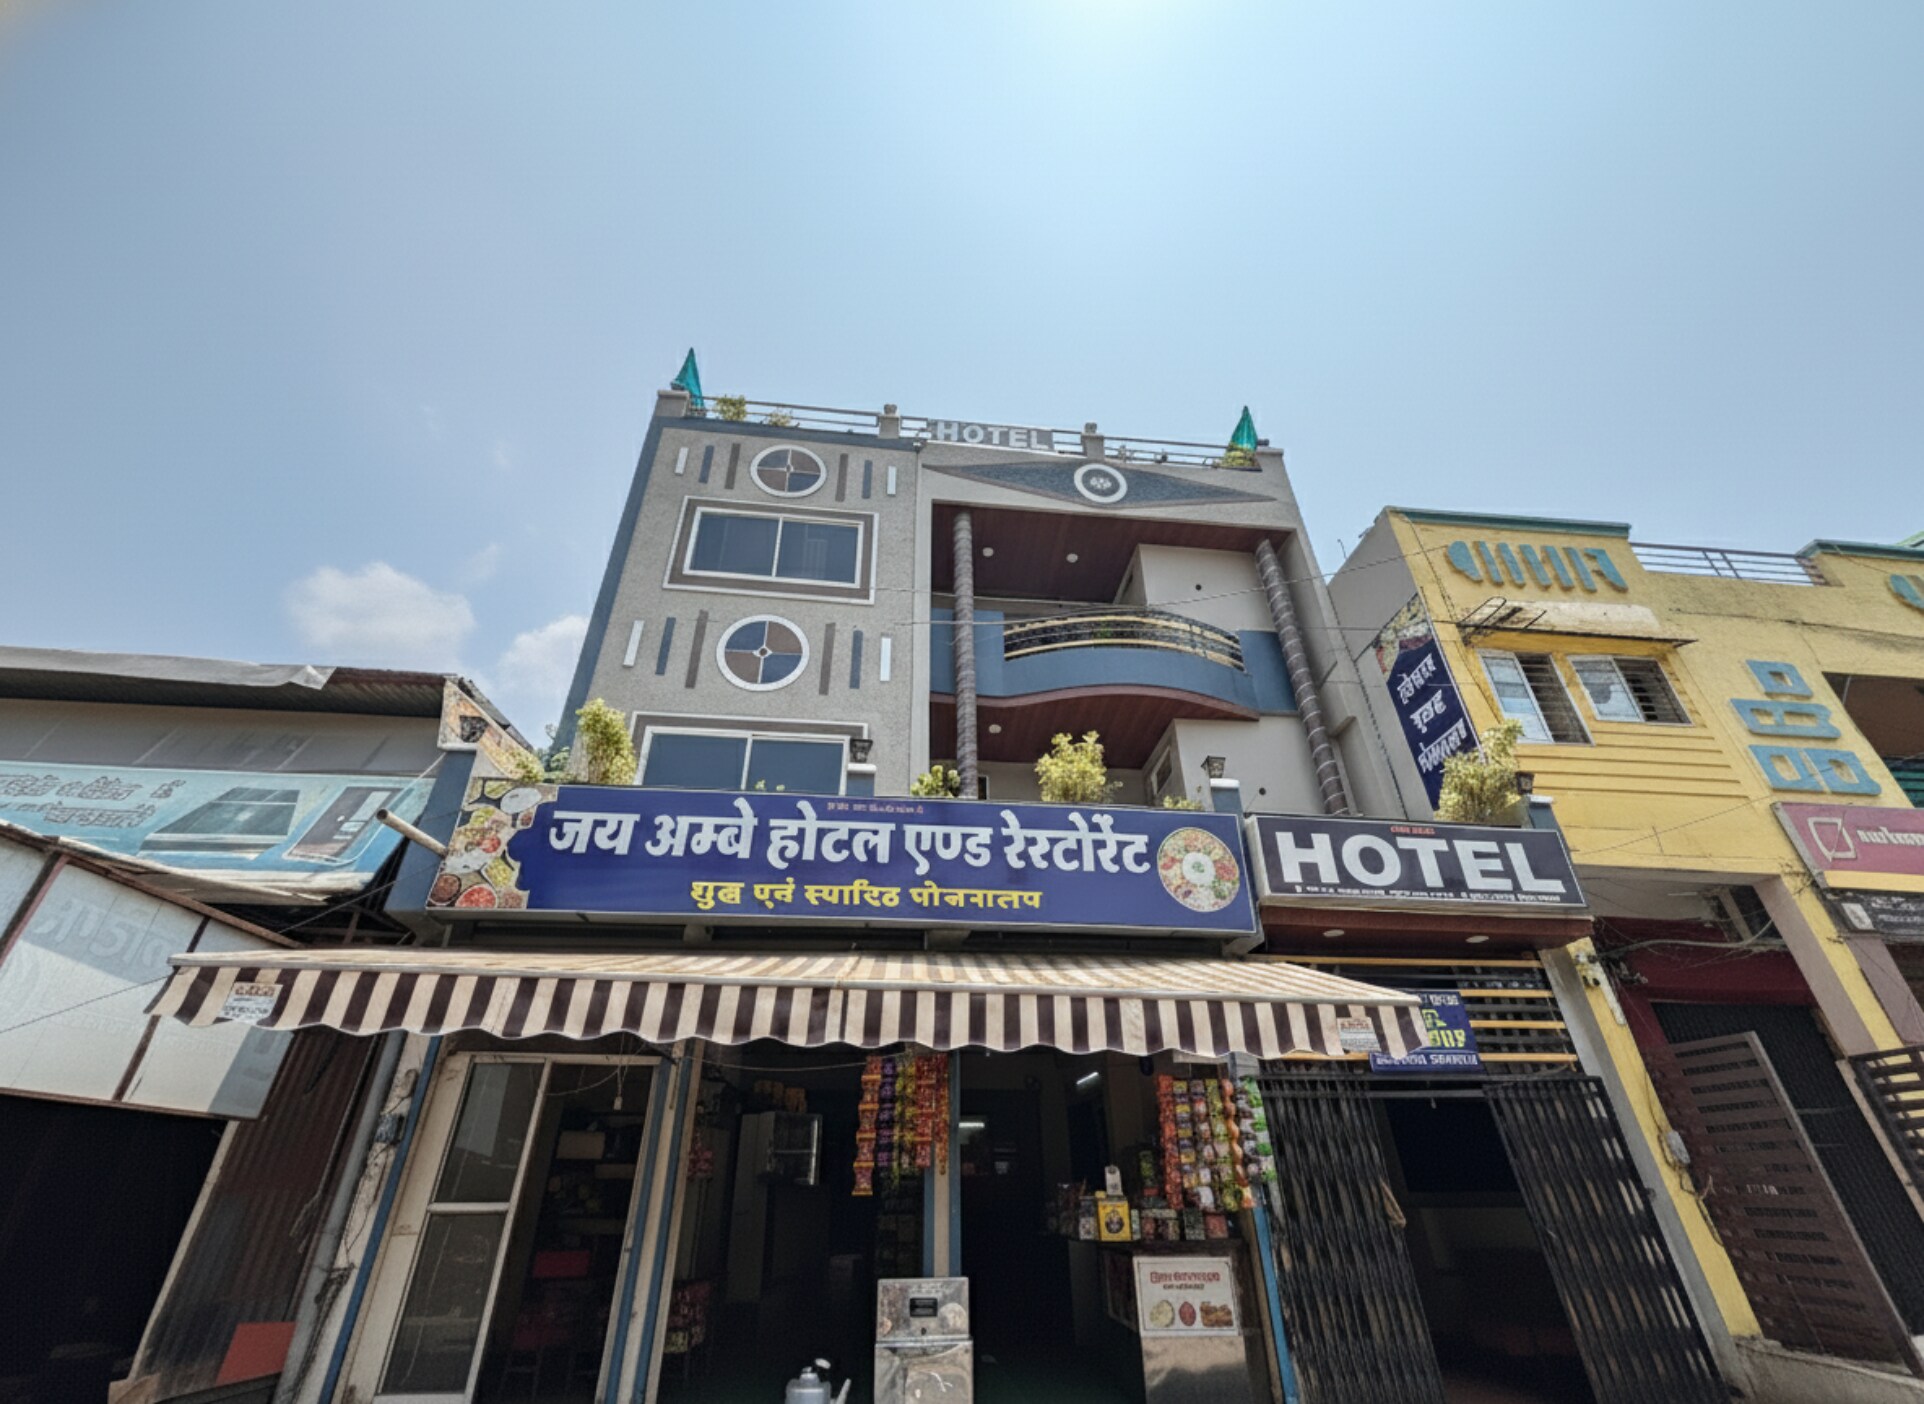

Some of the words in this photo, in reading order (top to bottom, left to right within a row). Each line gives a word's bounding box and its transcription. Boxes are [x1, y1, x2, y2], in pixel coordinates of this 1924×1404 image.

[938, 421, 1049, 449] HOTEL
[549, 810, 641, 856] जय
[645, 797, 758, 859] अम्बे
[766, 800, 896, 870] होटल
[903, 824, 994, 876] एण्ड
[1275, 831, 1567, 893] HOTEL
